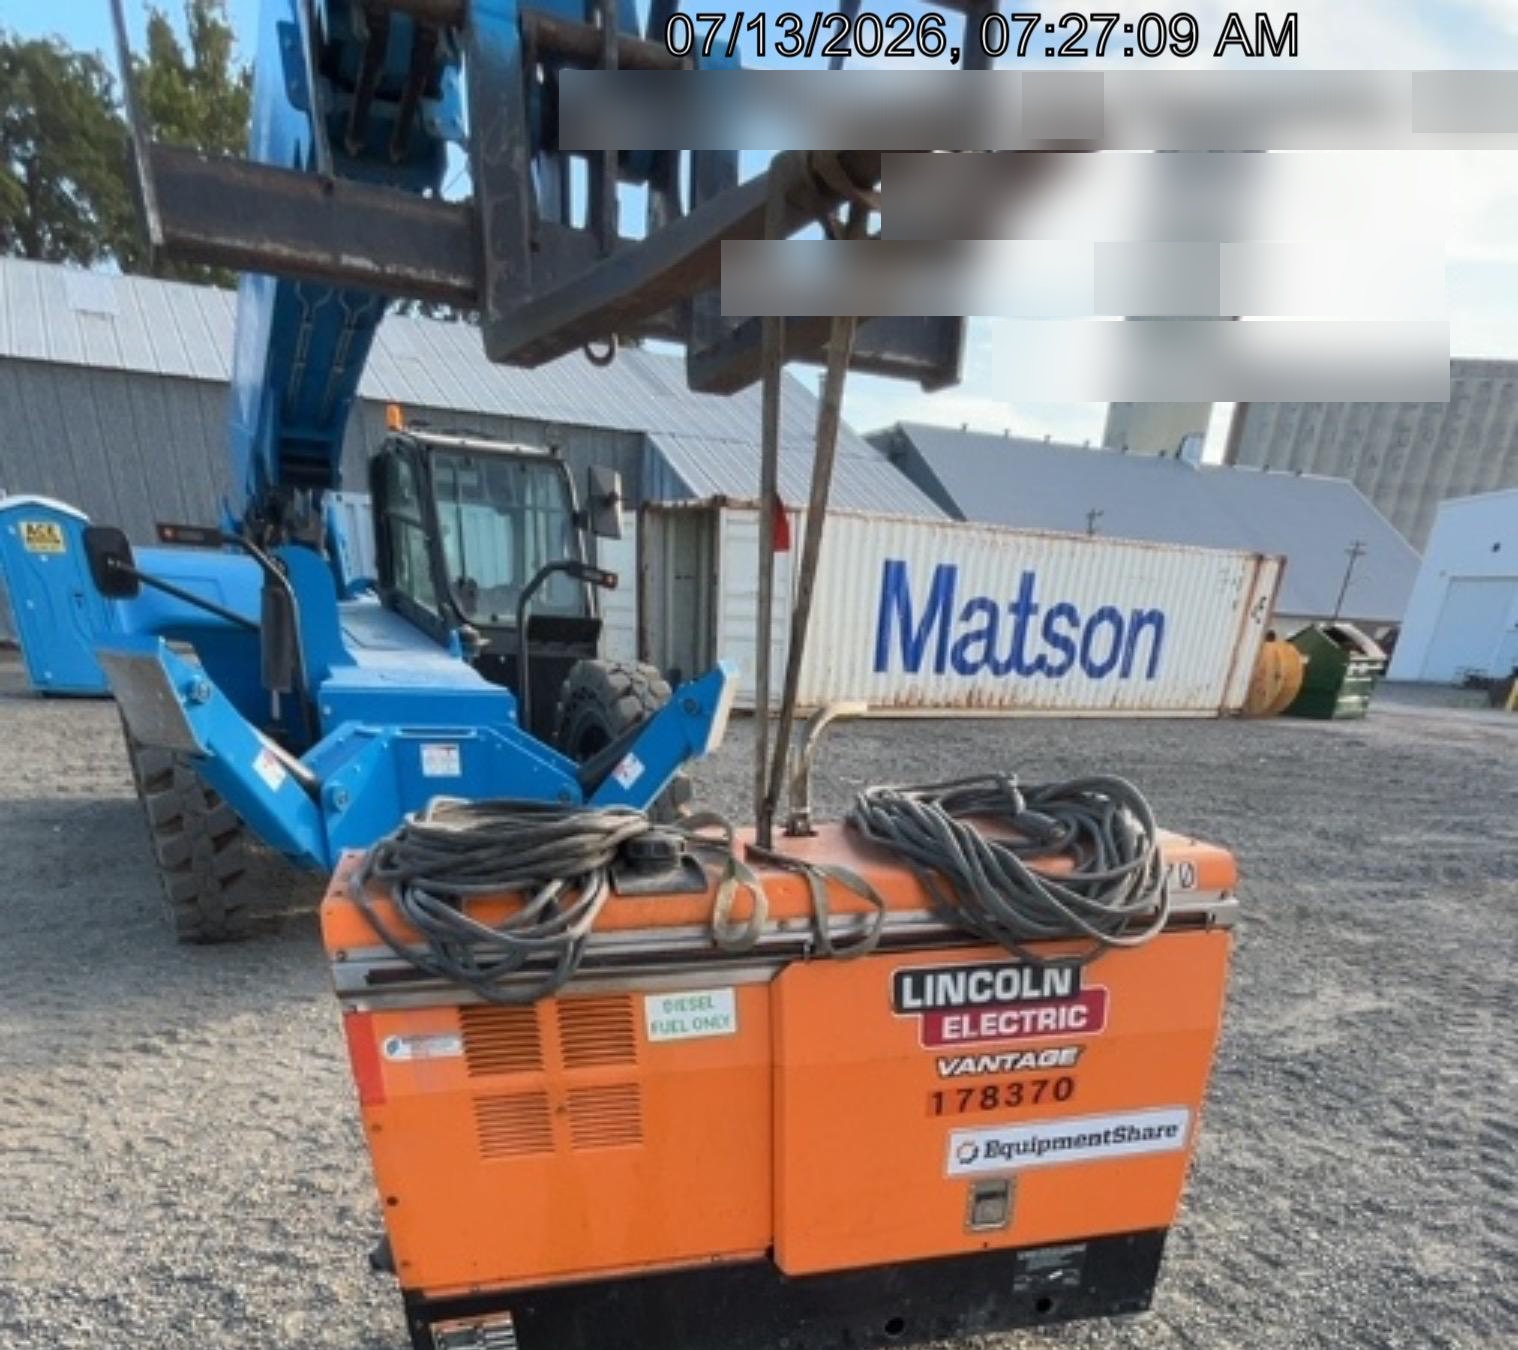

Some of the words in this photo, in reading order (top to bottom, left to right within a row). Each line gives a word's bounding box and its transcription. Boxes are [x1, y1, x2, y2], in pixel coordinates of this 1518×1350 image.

[873, 558, 1166, 681] Matson
[663, 996, 715, 1013] DIESEL
[902, 967, 1072, 1009] LINCOLN
[652, 1020, 689, 1035] FUEL
[693, 1015, 731, 1031] ONLY
[941, 1004, 1089, 1040] ELECTRIC
[936, 1046, 1082, 1078] VANTAGE
[931, 1077, 1075, 1115] 178370
[983, 1122, 1178, 1160] EquipmentShare
